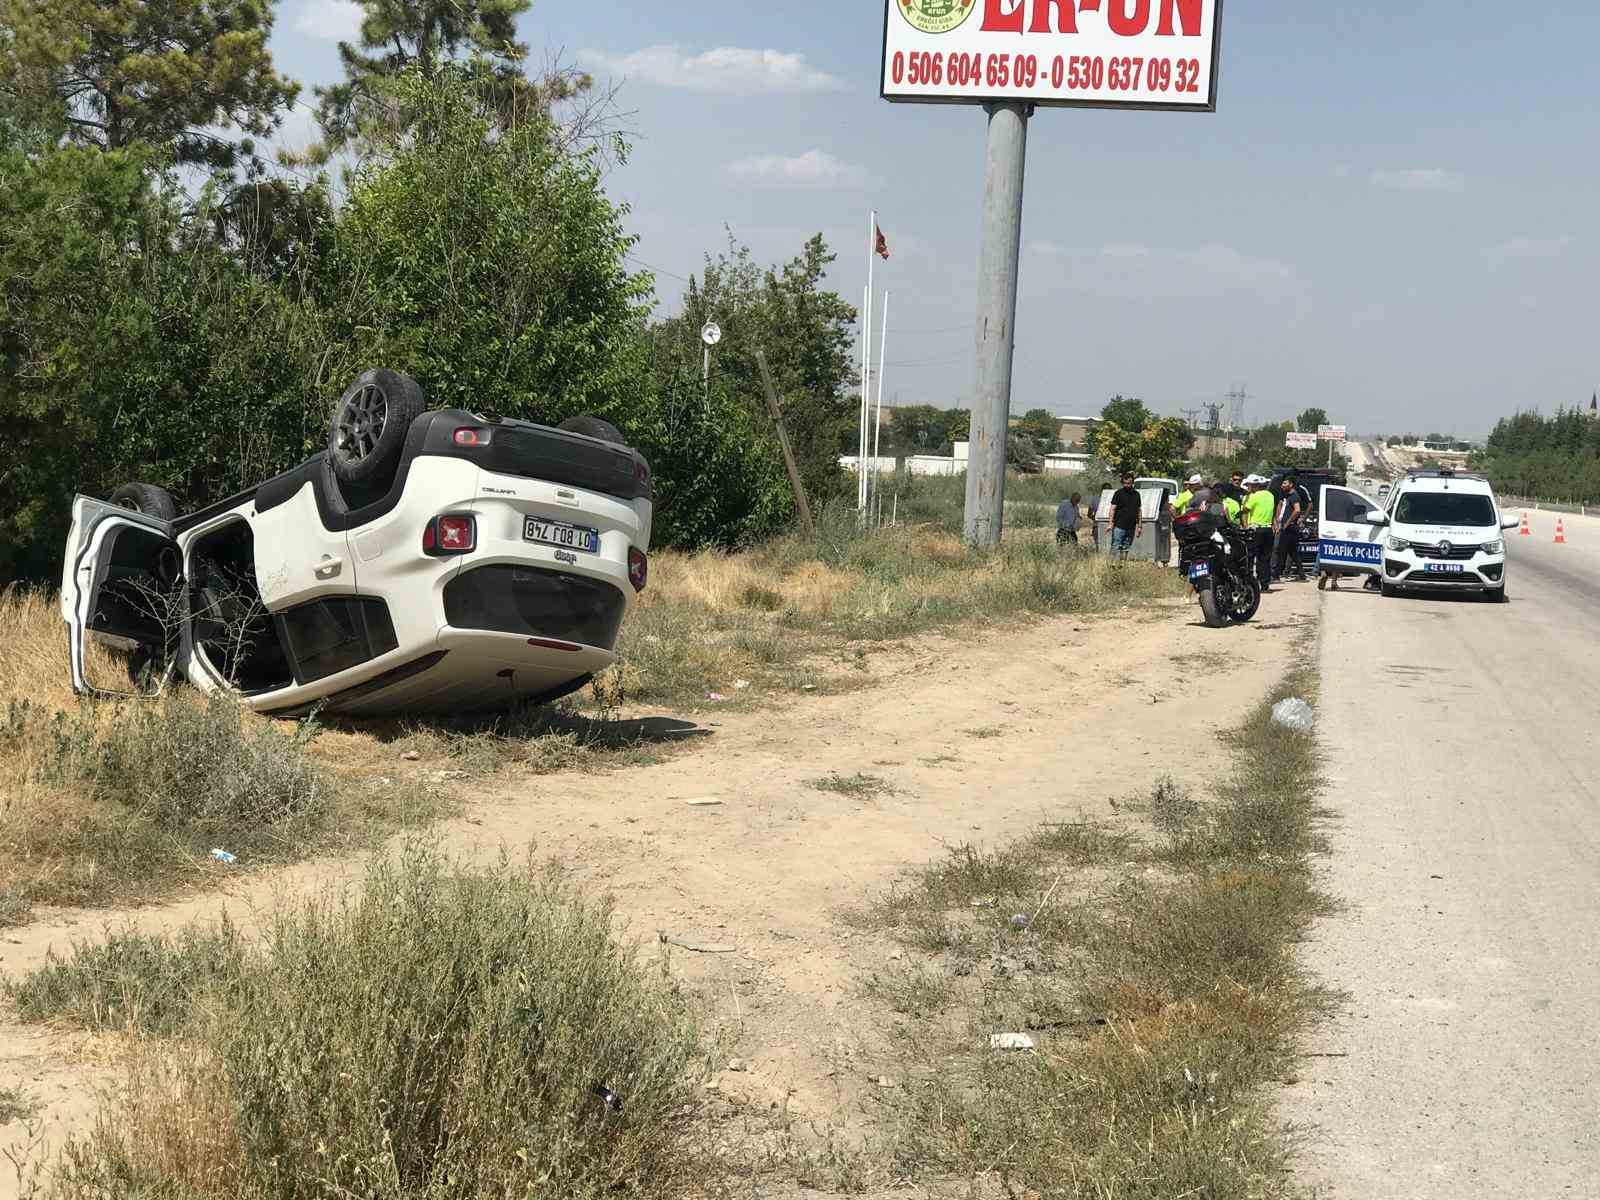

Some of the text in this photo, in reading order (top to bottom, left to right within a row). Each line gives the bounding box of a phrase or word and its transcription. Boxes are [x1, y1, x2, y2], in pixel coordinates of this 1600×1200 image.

[892, 51, 904, 85] 0
[907, 51, 943, 86] 506
[947, 52, 982, 87] 604
[986, 54, 1010, 87] 65
[1013, 54, 1038, 88] 09
[1051, 55, 1065, 89] 0
[1067, 56, 1105, 90] 530
[1107, 57, 1144, 91] 637
[1147, 58, 1171, 92] 09
[1175, 58, 1200, 92] 32
[527, 521, 590, 548] 01 BDJ 748
[1323, 543, 1353, 558] TRAFİK
